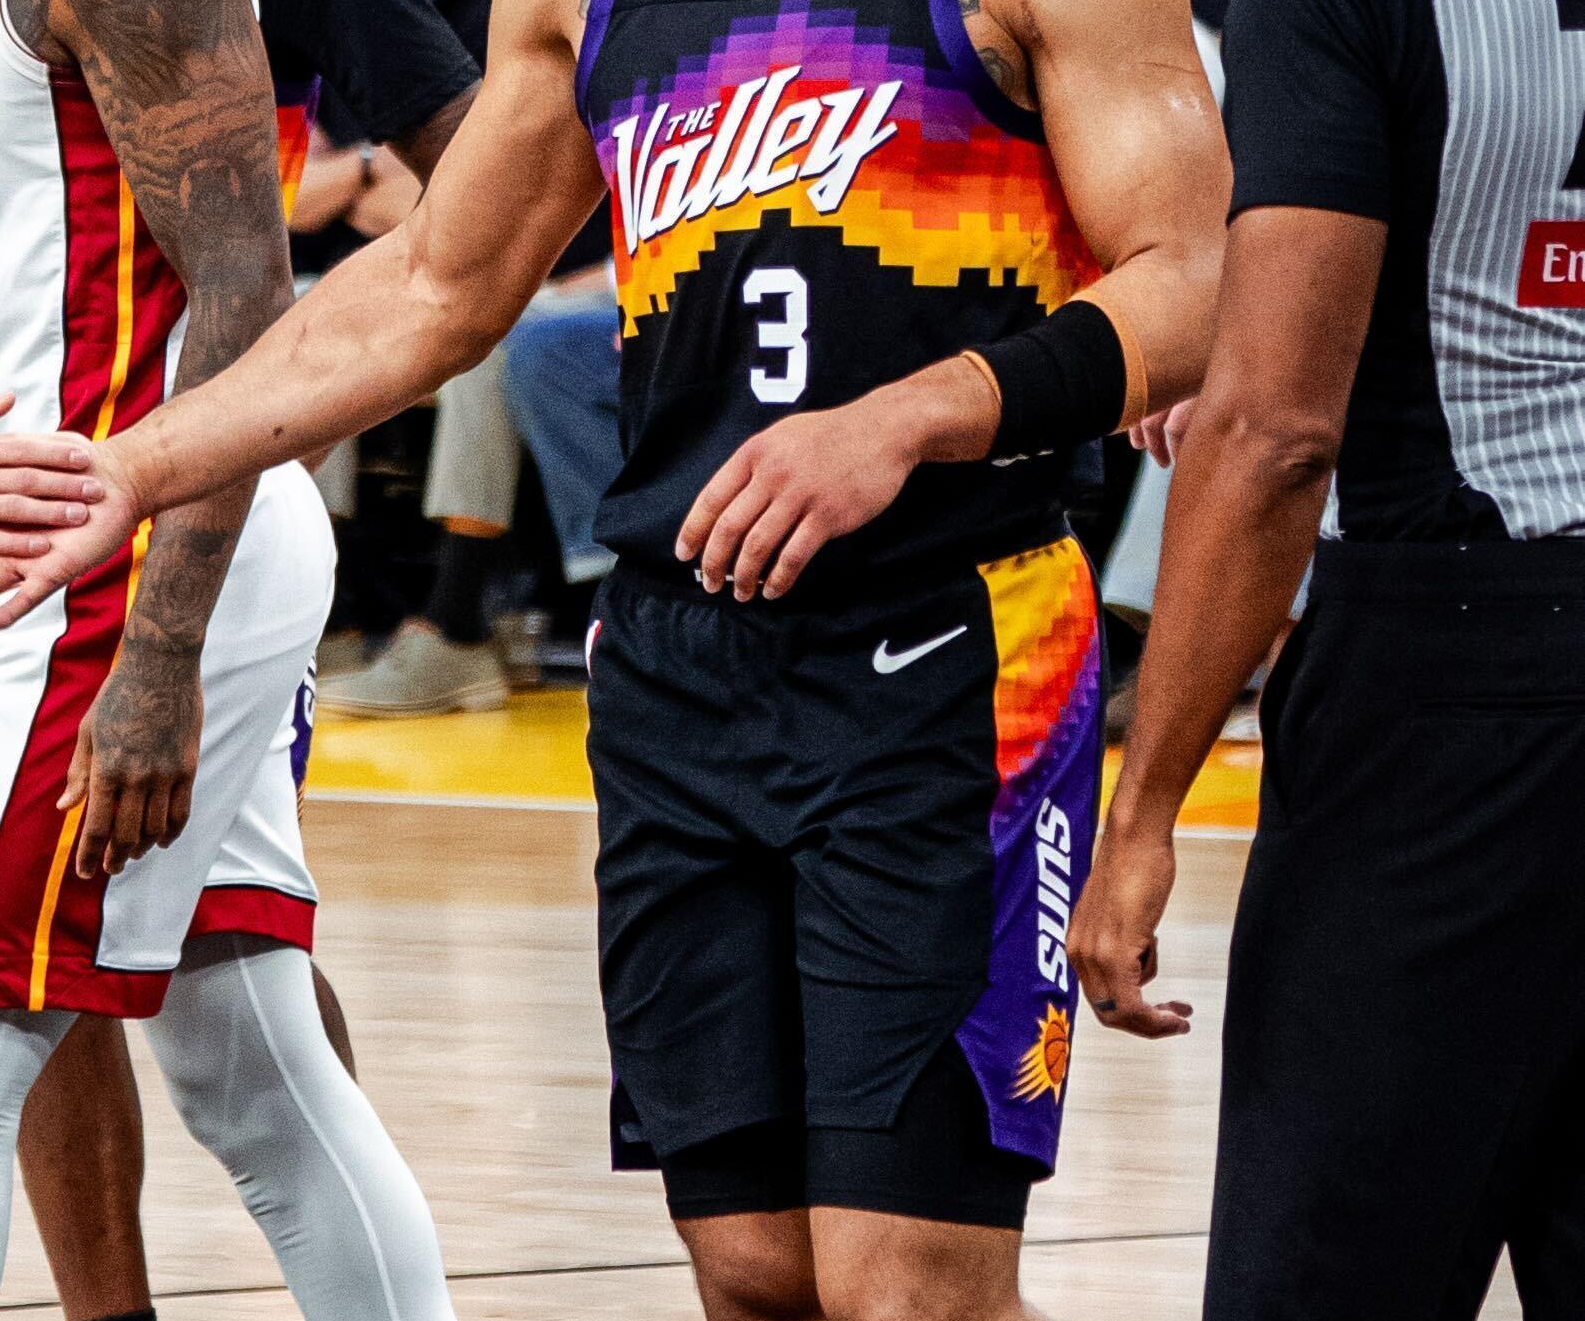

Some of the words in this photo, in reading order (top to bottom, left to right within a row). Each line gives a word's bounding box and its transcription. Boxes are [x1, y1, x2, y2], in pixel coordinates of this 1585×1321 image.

[613, 65, 904, 258] Valley
[667, 101, 722, 143] THE
[742, 267, 808, 403] 3
[1035, 796, 1072, 993] SUNS
